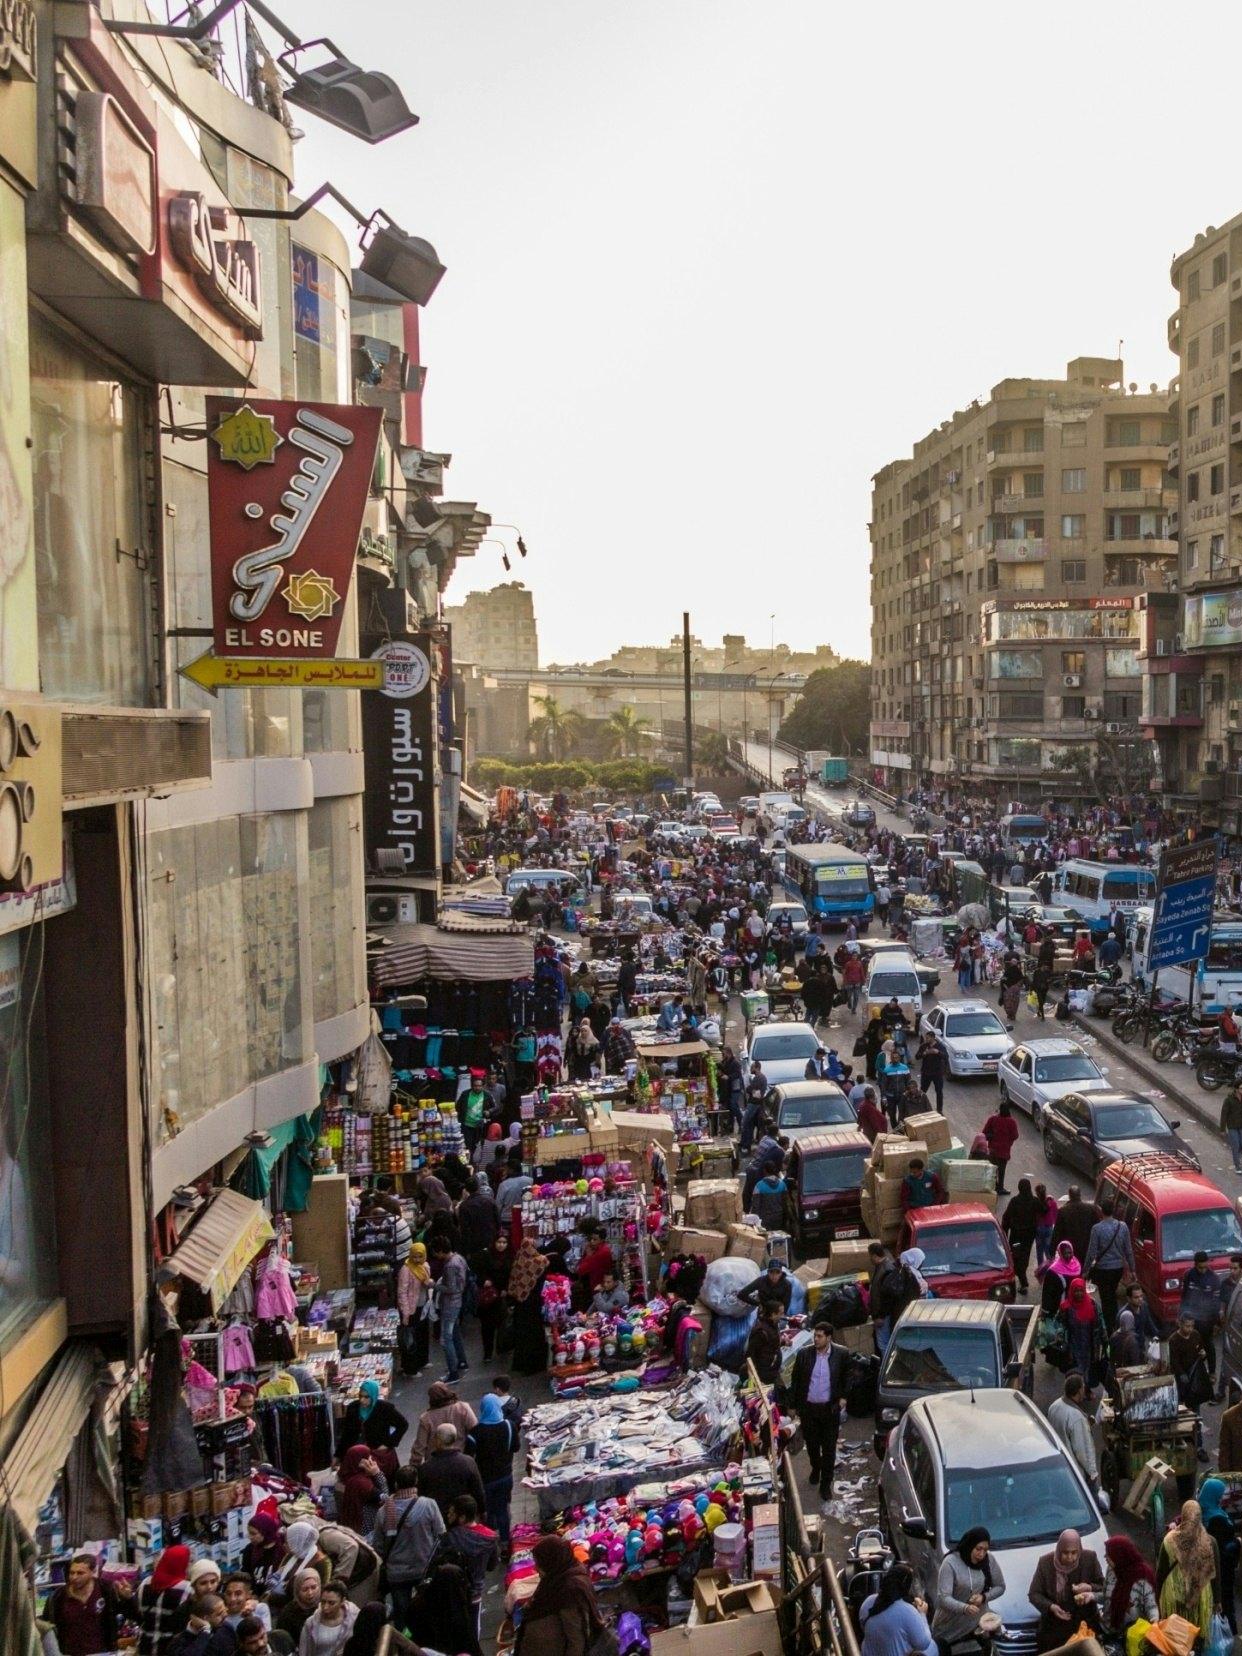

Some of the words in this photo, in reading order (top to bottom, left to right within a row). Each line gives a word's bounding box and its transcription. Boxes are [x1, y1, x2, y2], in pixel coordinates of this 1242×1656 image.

[225, 628, 254, 647] EL
[259, 628, 324, 648] SONE
[224, 663, 299, 682] الجاهزة
[303, 665, 377, 683] للملابس
